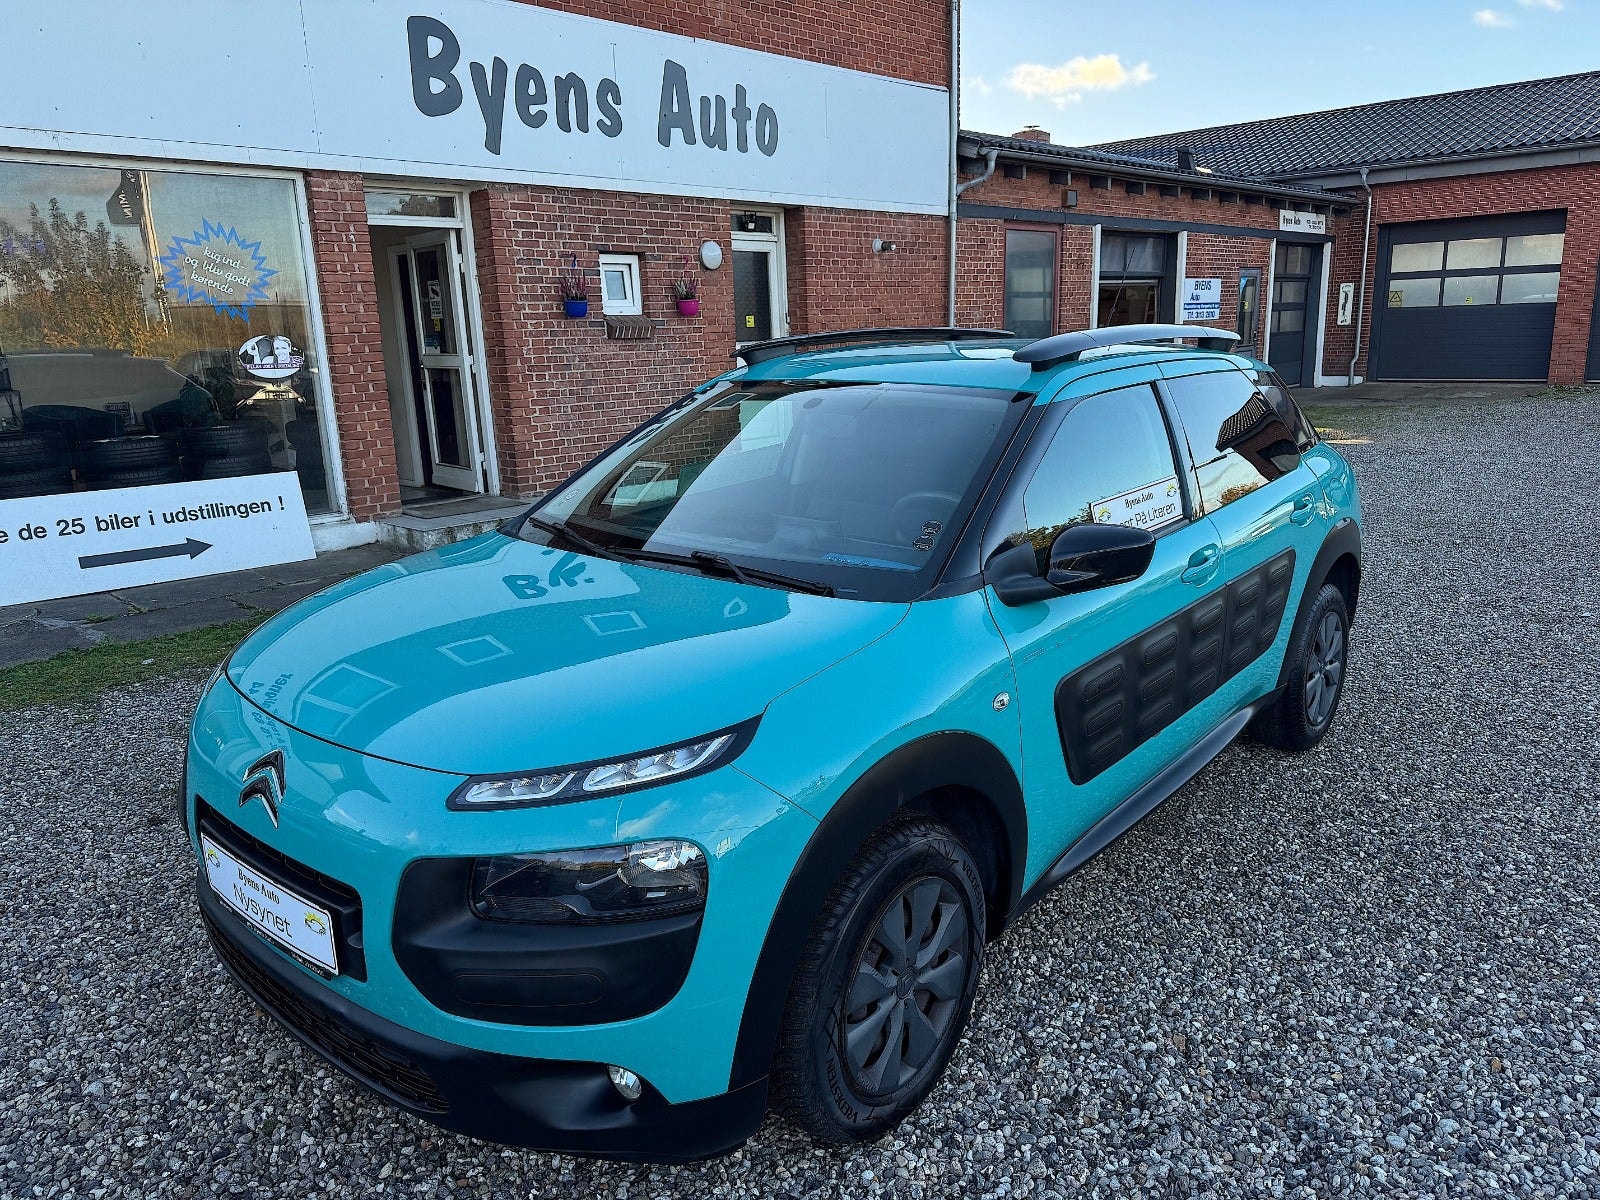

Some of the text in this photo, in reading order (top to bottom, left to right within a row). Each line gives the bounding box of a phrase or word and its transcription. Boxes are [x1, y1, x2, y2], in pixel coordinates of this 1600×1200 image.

[406, 15, 779, 157] Byens Auto
[203, 246, 221, 264] kig
[184, 256, 251, 287] og bliv godt
[190, 270, 234, 295] kørende
[1194, 280, 1212, 291] BYENS
[1189, 292, 1201, 302] Auto
[1124, 491, 1154, 509] Byens Auto
[1134, 510, 1148, 526] På
[1147, 502, 1176, 522] Literen
[18, 523, 48, 541] de
[56, 517, 86, 537] 25
[95, 514, 141, 532] biler
[148, 510, 155, 526] i
[162, 498, 272, 525] udstillingen
[278, 495, 285, 511] !
[237, 867, 280, 905] Byens Auto
[233, 883, 293, 938] Nysynet
[825, 1056, 859, 1125] VREDESTEIN
